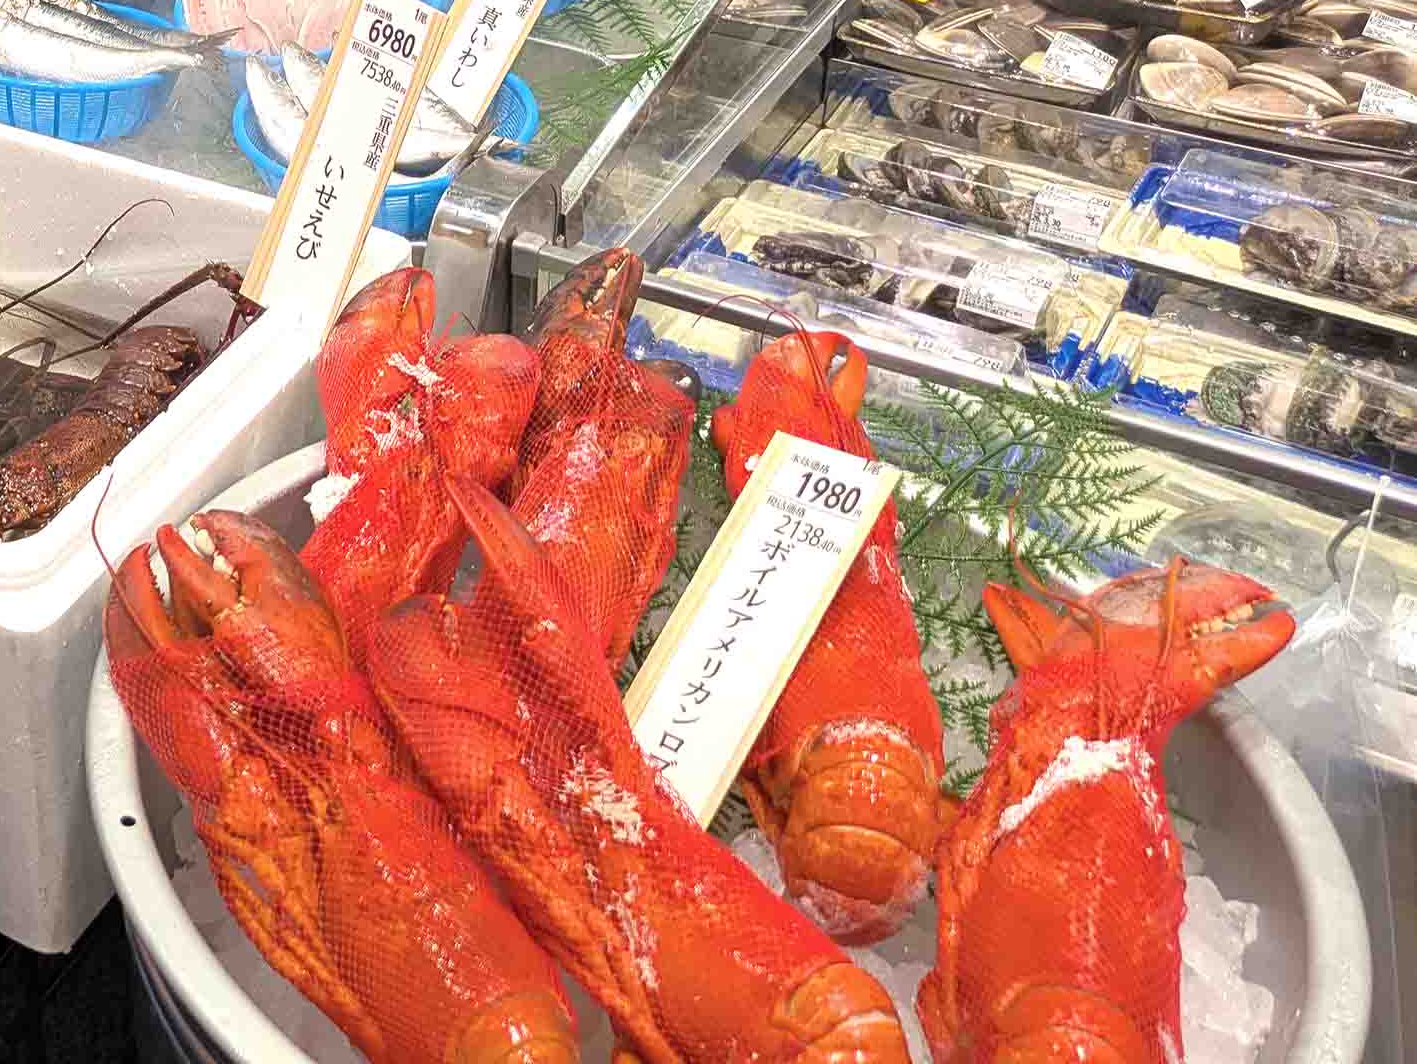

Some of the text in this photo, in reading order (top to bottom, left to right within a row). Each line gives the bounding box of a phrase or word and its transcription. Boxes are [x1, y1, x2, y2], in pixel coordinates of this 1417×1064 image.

[414, 7, 429, 25] 1尾
[451, 5, 503, 88] 真いわし
[364, 96, 399, 171] 三重県産
[296, 155, 344, 260] いせえび
